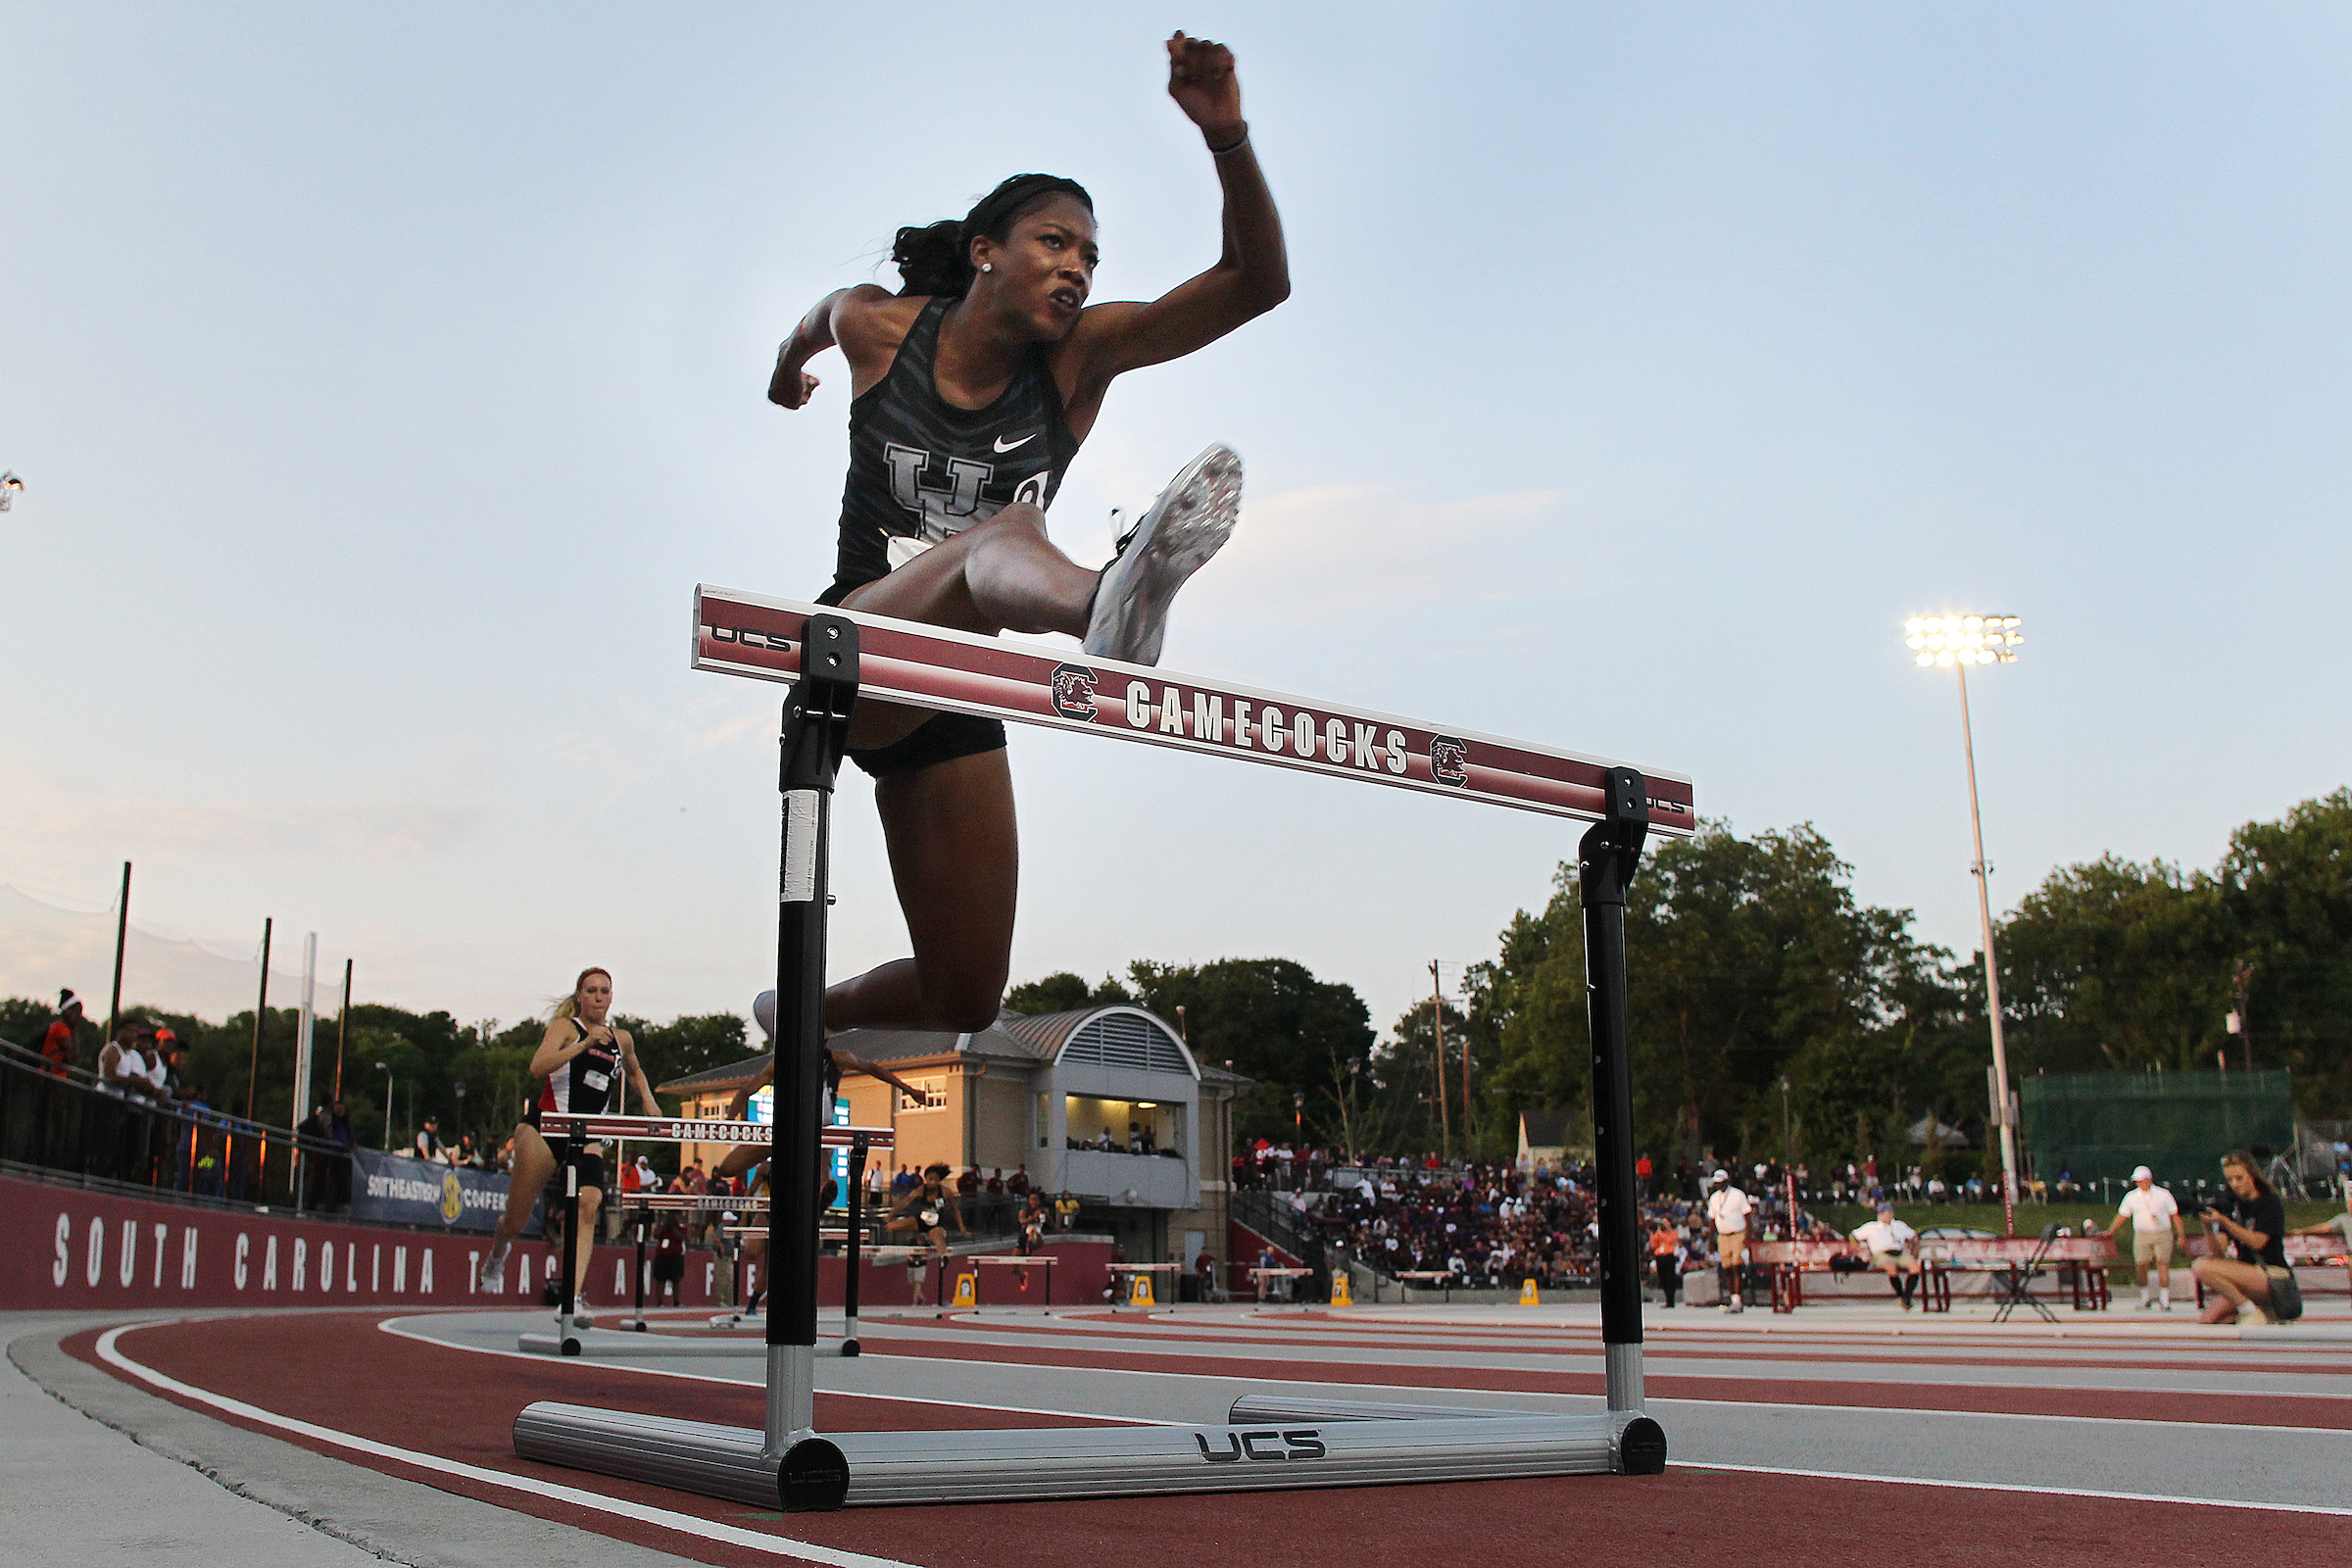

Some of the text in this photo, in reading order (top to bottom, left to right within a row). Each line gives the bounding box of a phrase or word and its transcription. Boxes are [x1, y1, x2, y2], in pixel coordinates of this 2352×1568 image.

[710, 622, 791, 653] UCS
[1126, 679, 1408, 775] GAMECOCKS
[670, 1122, 773, 1143] GAMECOCKS
[463, 1188, 510, 1212] CONFER
[52, 1211, 198, 1290] SOUTH
[233, 1232, 434, 1295] CAROLINA
[1193, 1429, 1327, 1463] UCS
